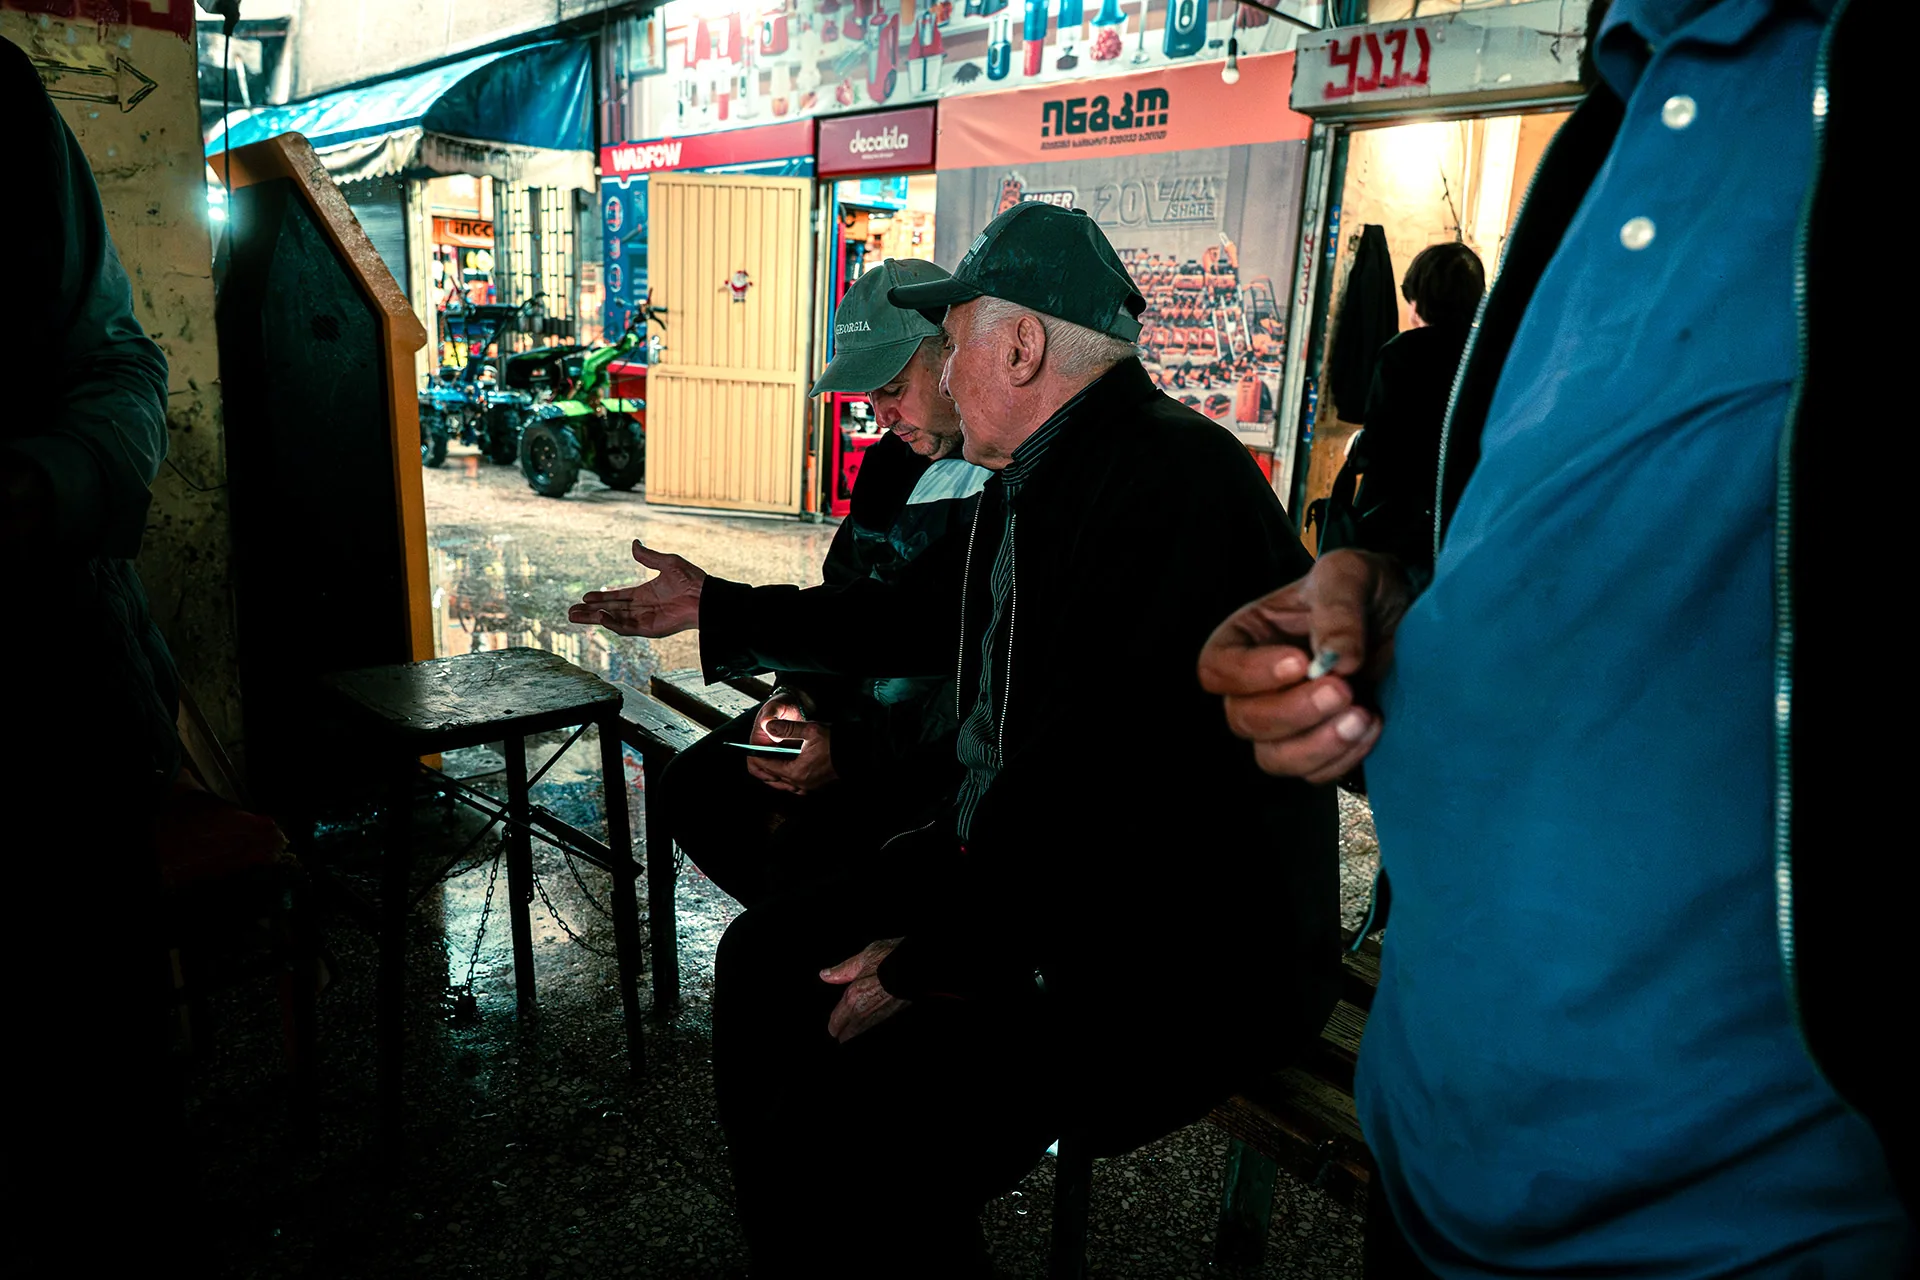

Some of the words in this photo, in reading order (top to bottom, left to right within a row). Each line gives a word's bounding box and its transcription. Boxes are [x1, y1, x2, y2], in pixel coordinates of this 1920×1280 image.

[1324, 27, 1431, 99] ყავა
[1041, 87, 1169, 137] ინგკო
[849, 125, 908, 153] decakila
[611, 142, 682, 171] WADFOW
[1024, 192, 1074, 209] SUPER
[1170, 202, 1214, 217] SHARE
[836, 320, 872, 335] GEORGIA
